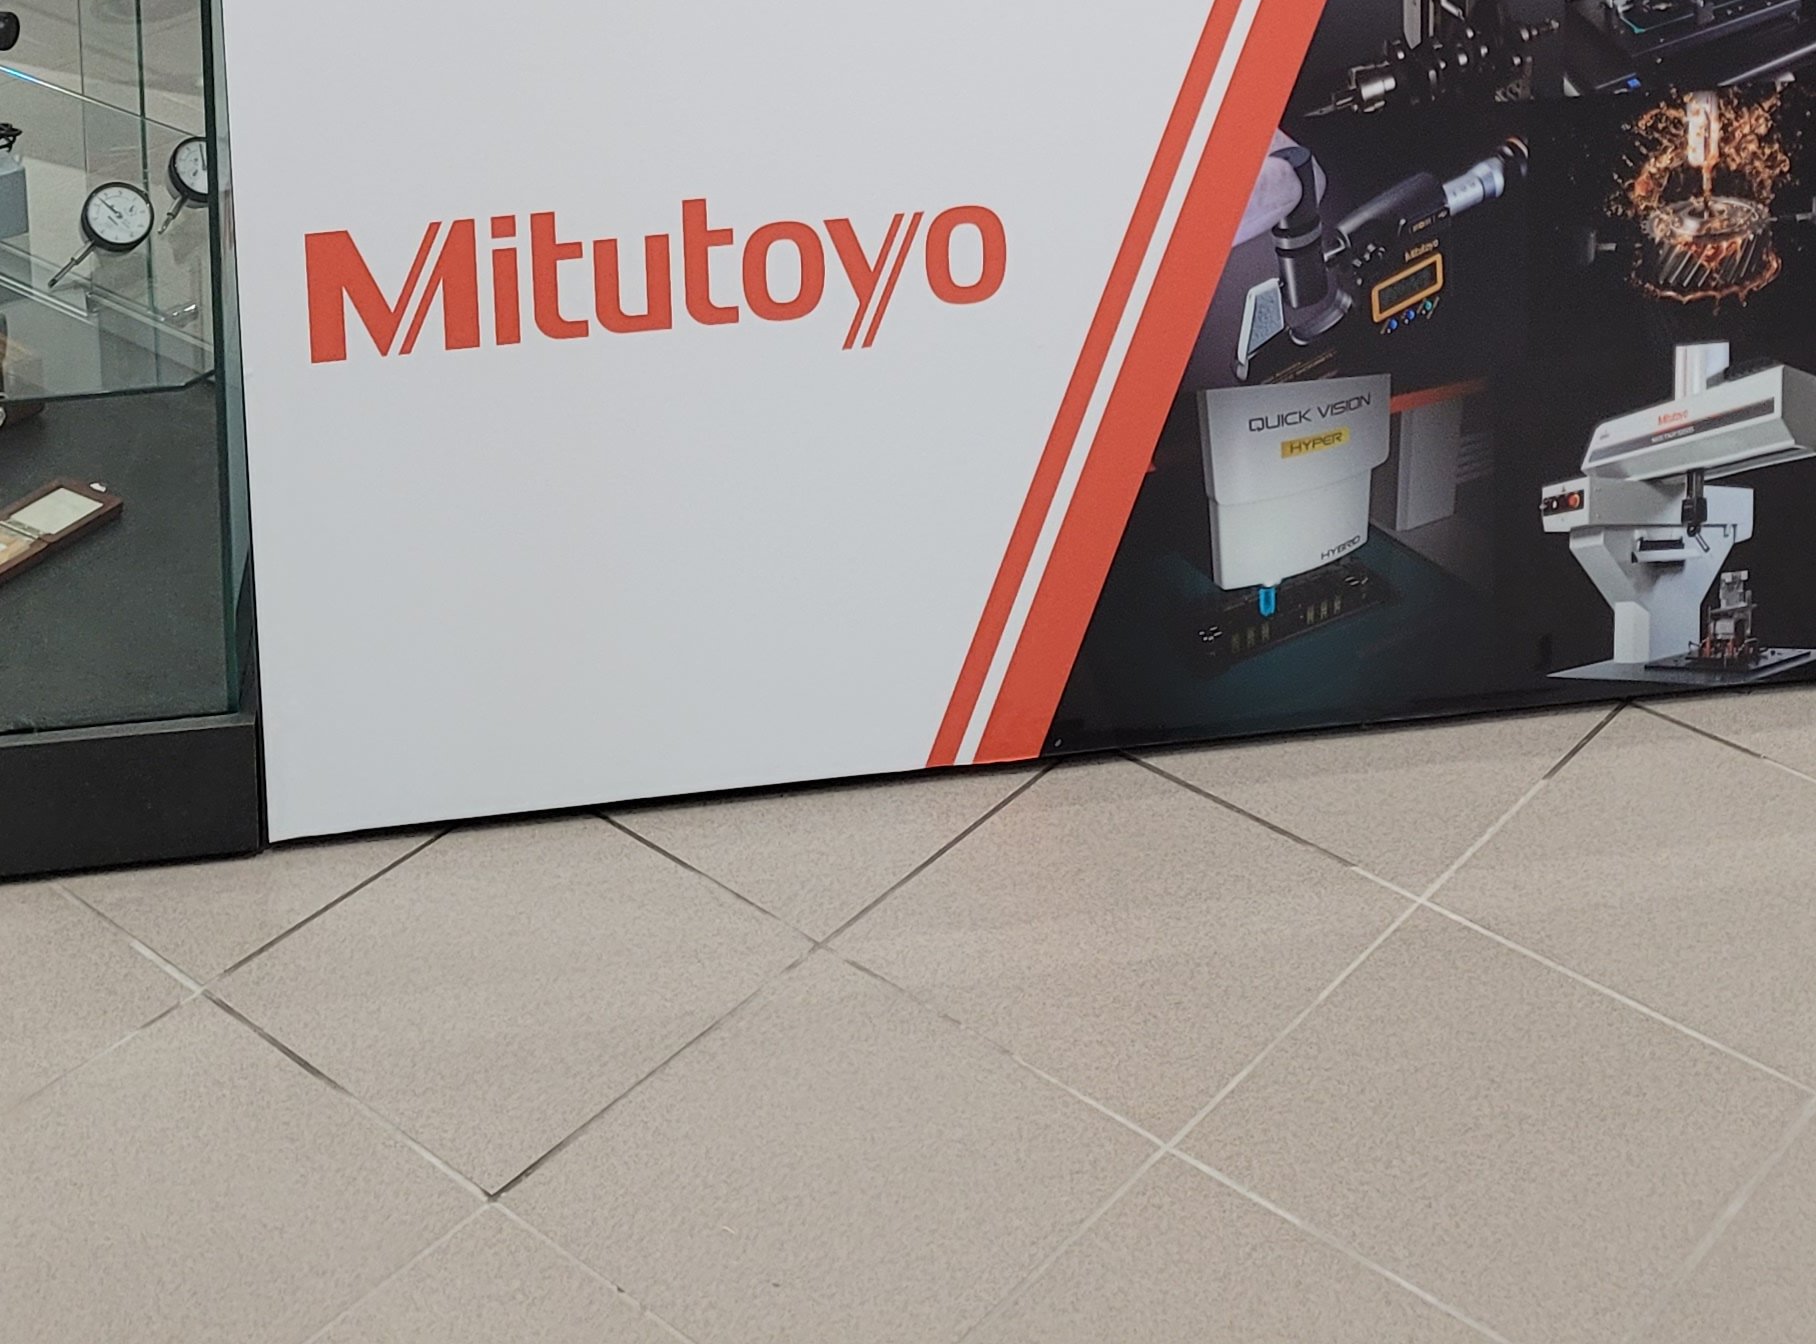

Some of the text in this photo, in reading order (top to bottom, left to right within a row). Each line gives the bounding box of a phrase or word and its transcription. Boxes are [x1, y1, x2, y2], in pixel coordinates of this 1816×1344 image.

[304, 197, 1008, 365] Mitutoyo
[1248, 392, 1372, 432] QUICK VISION
[1289, 432, 1343, 454] HYPER
